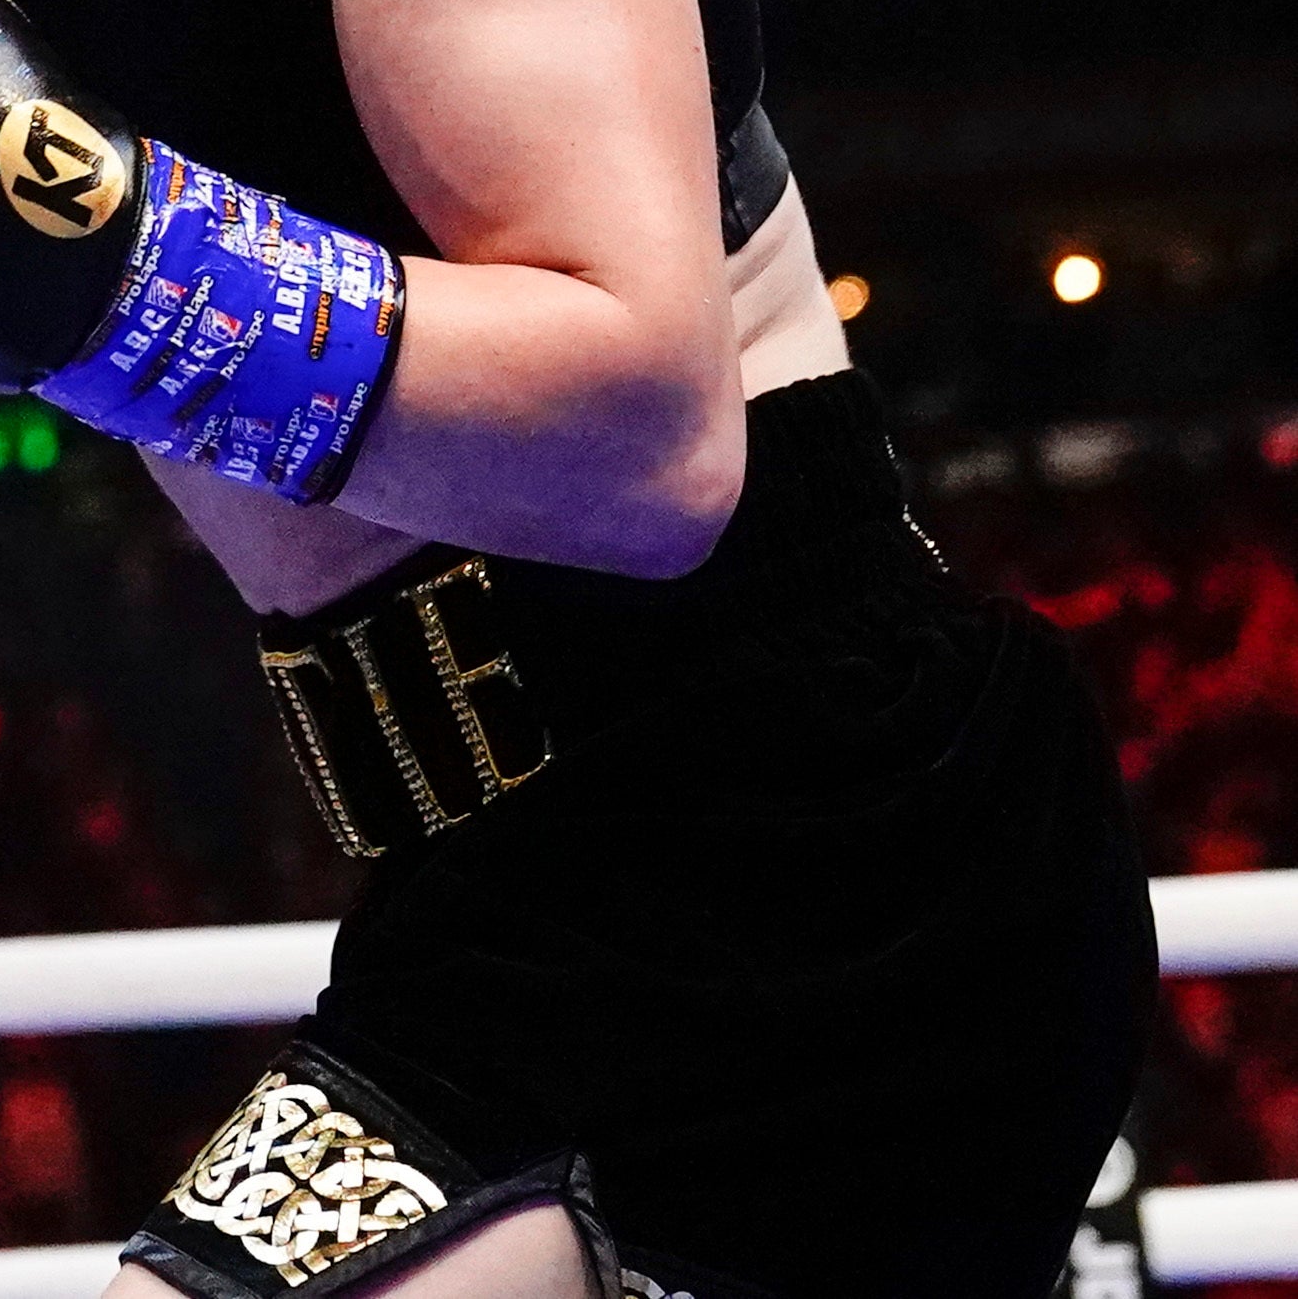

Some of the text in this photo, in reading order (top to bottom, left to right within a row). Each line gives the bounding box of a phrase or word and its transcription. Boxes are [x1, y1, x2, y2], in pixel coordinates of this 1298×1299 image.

[272, 263, 308, 335] A.B.C
[310, 293, 332, 359] empire
[109, 308, 171, 373] A.B.C
